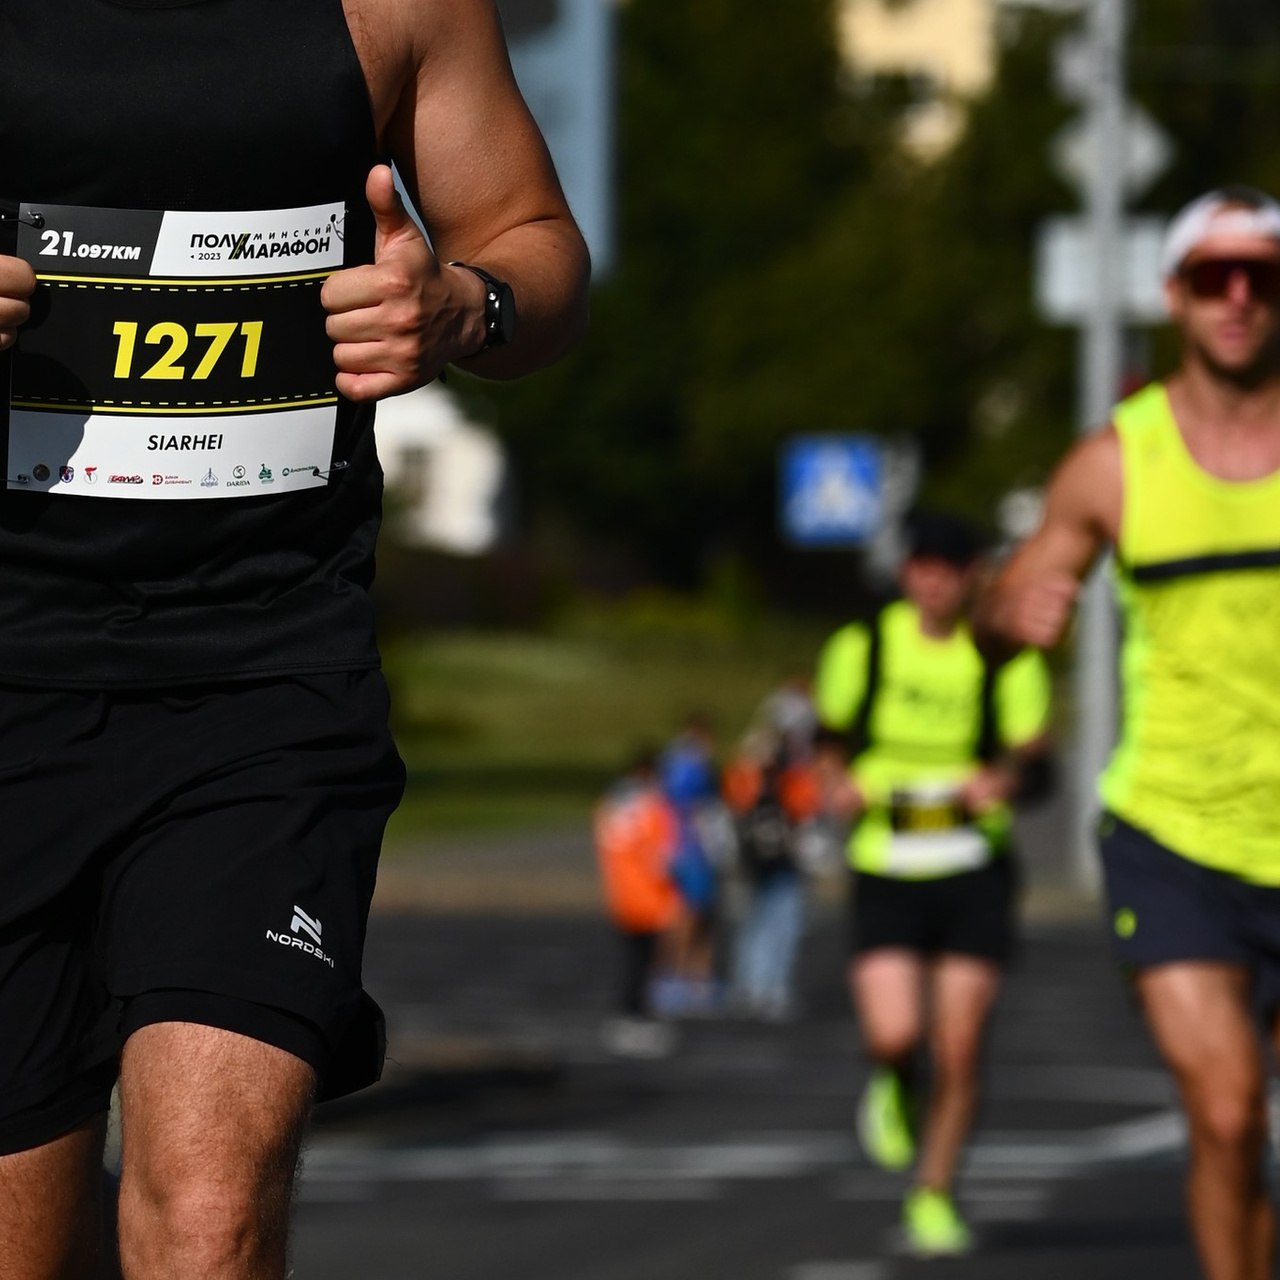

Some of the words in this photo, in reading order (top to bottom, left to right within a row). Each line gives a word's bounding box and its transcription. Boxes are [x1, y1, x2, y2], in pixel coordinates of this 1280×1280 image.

[253, 225, 332, 240] МИНСКИЙ
[198, 252, 221, 261] 2023
[229, 236, 331, 260] МАРАФОН
[112, 320, 264, 380] 1271
[147, 434, 224, 451] SIARHEI
[266, 930, 334, 968] NORDSKI
